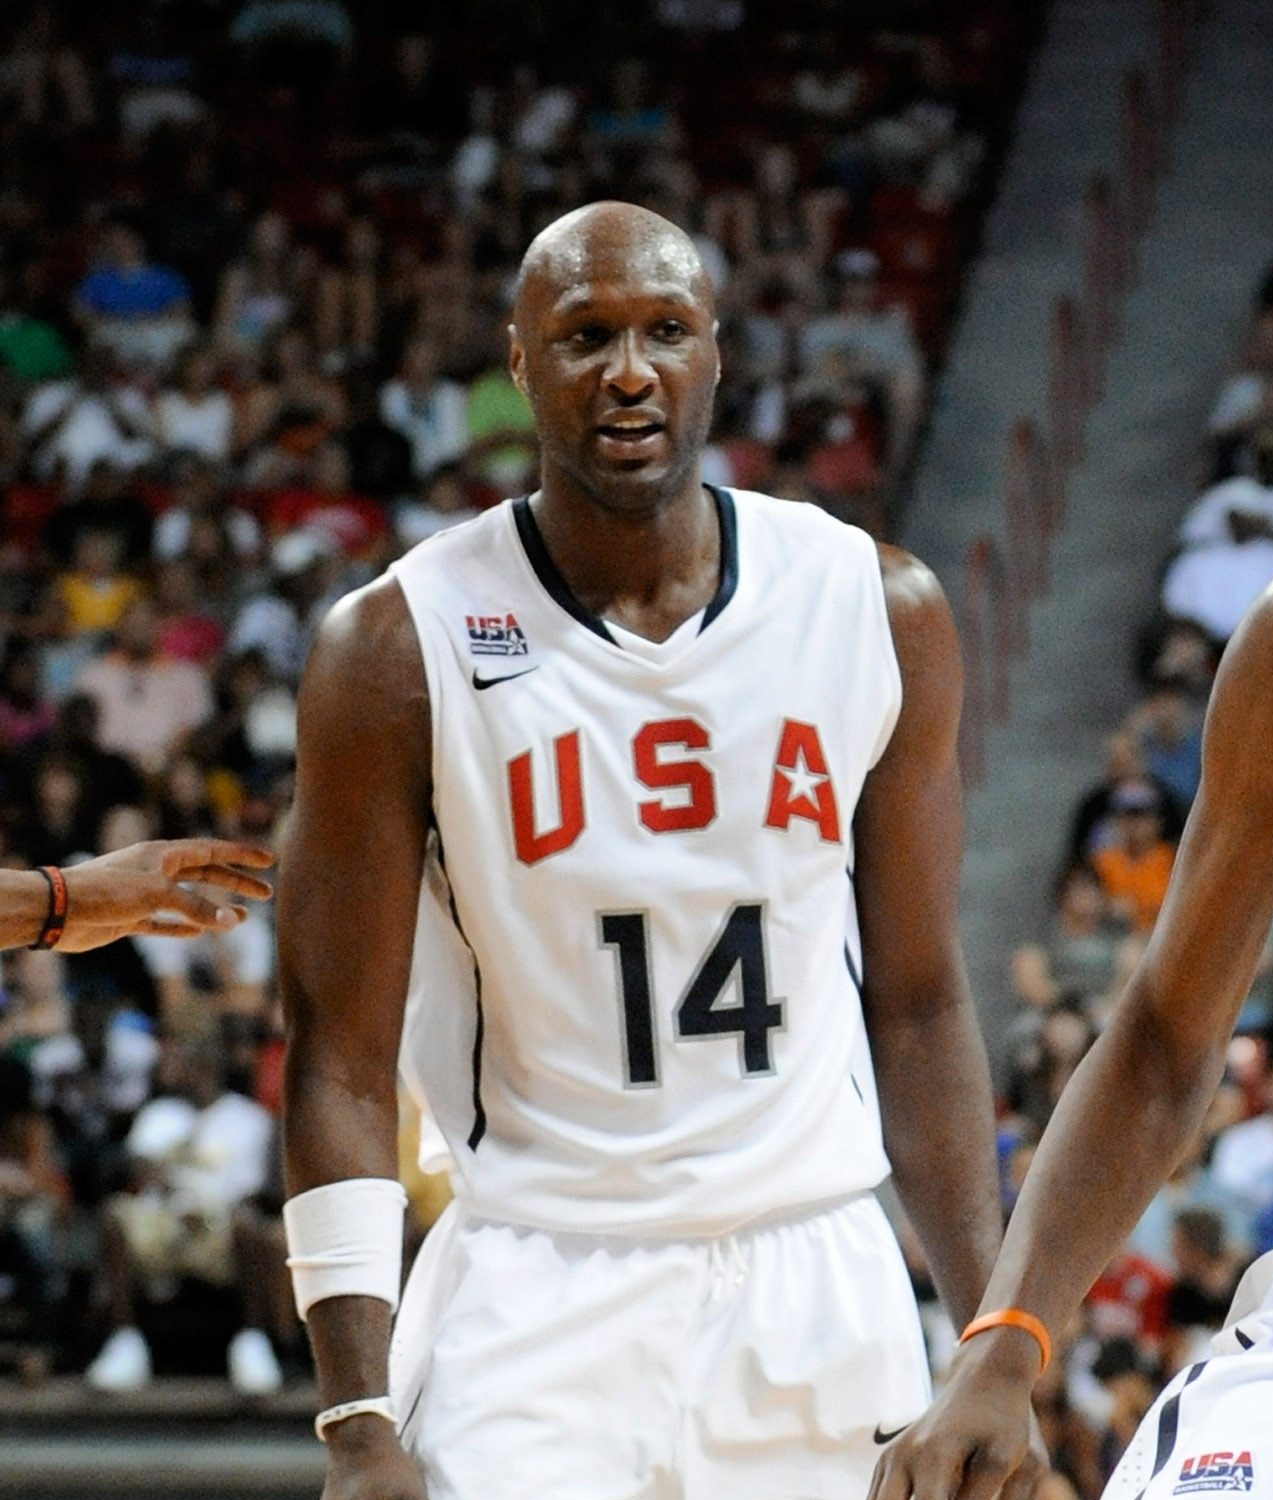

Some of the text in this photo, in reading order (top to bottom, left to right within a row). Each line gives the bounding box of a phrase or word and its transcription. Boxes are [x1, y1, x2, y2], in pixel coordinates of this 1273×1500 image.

[465, 612, 525, 642] USA
[506, 716, 843, 869] USA
[596, 898, 788, 1090] 14
[1178, 1450, 1254, 1482] USA
